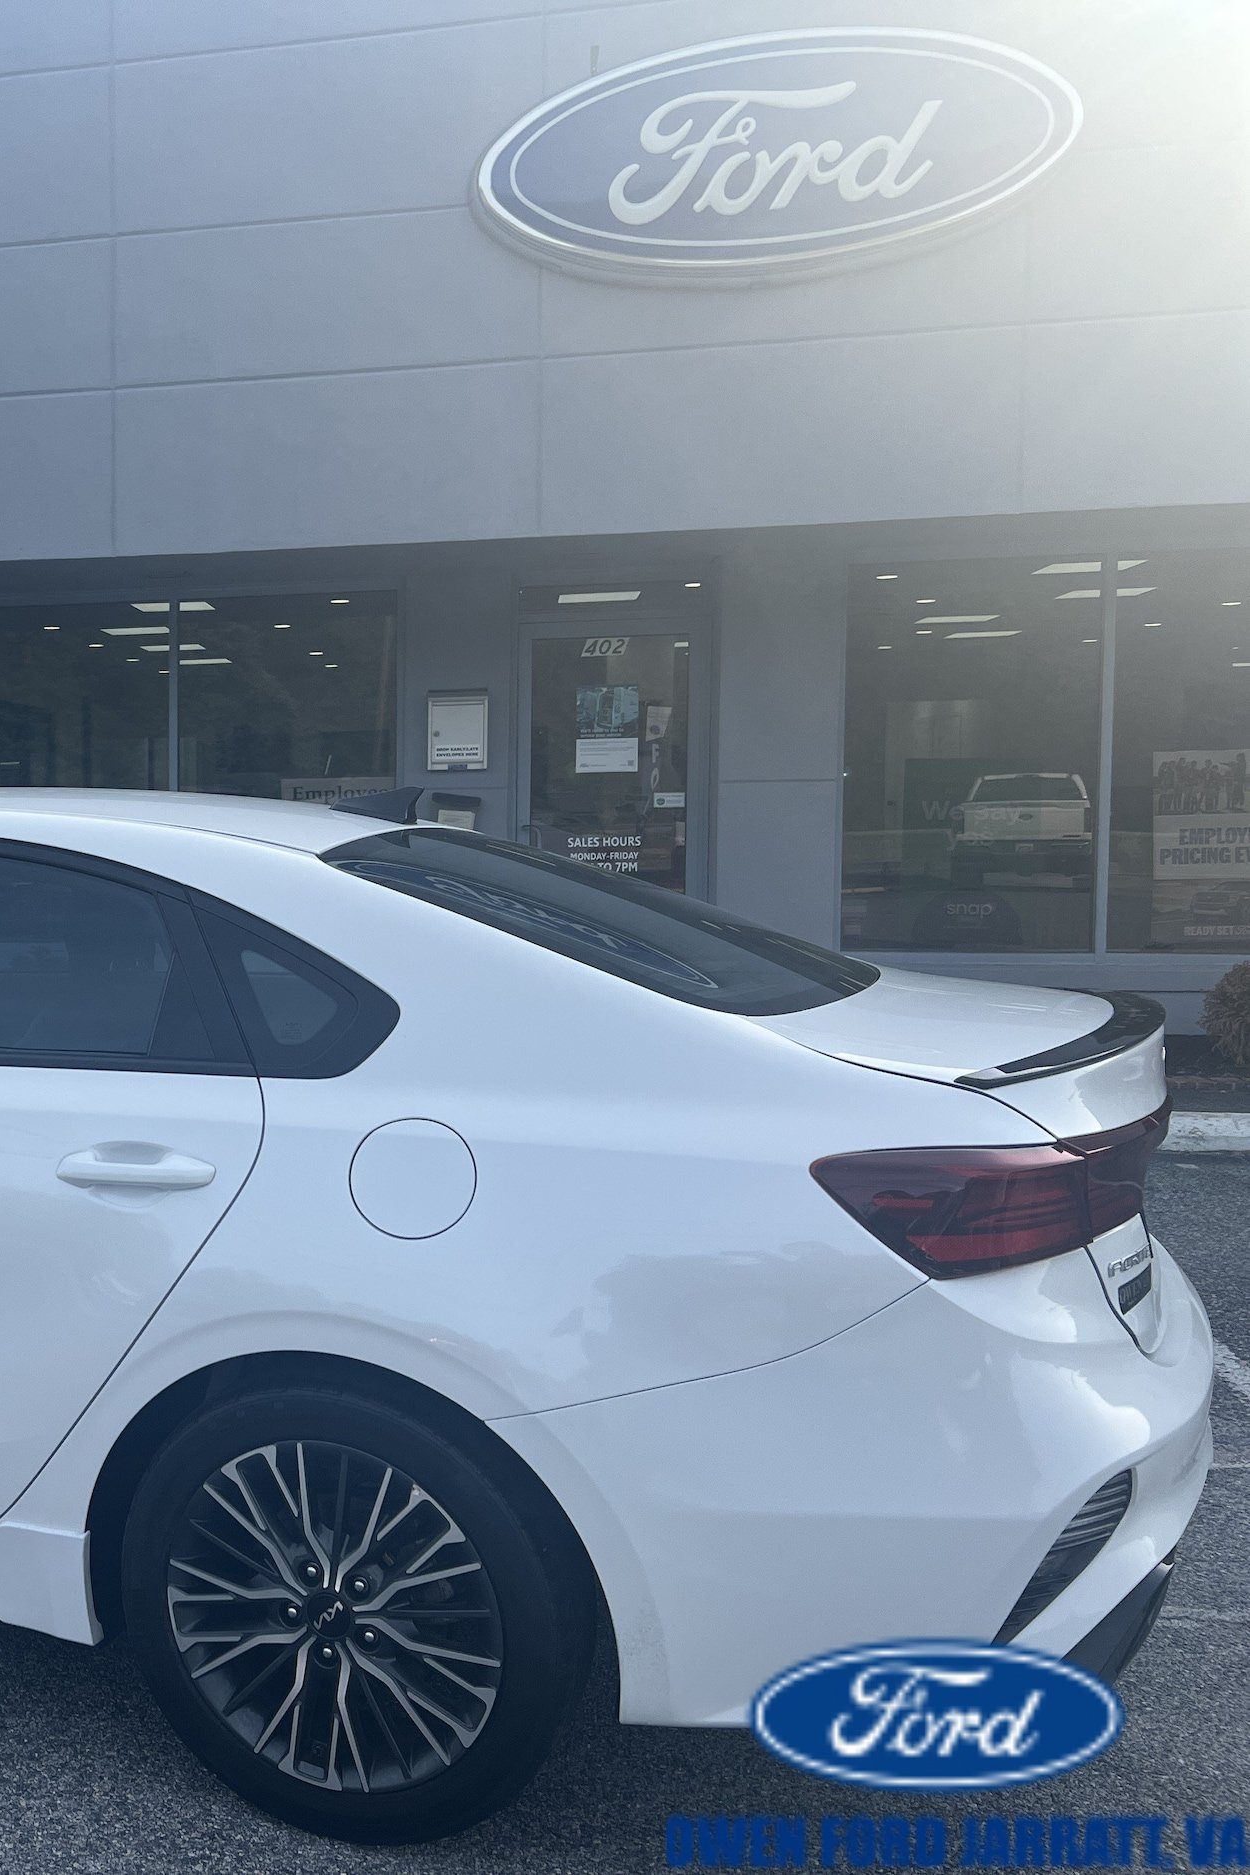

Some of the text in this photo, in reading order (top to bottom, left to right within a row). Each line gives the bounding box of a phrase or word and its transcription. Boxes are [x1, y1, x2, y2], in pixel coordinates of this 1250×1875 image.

[608, 81, 943, 225] Ford
[584, 638, 625, 655] 402
[567, 836, 642, 848] SALES HOURS
[1179, 827, 1250, 845] EMPLOY
[570, 851, 639, 861] MONDAY-FRIDAY
[1159, 847, 1230, 865] PRICING
[615, 862, 638, 872] 7PM
[946, 903, 992, 919] snap
